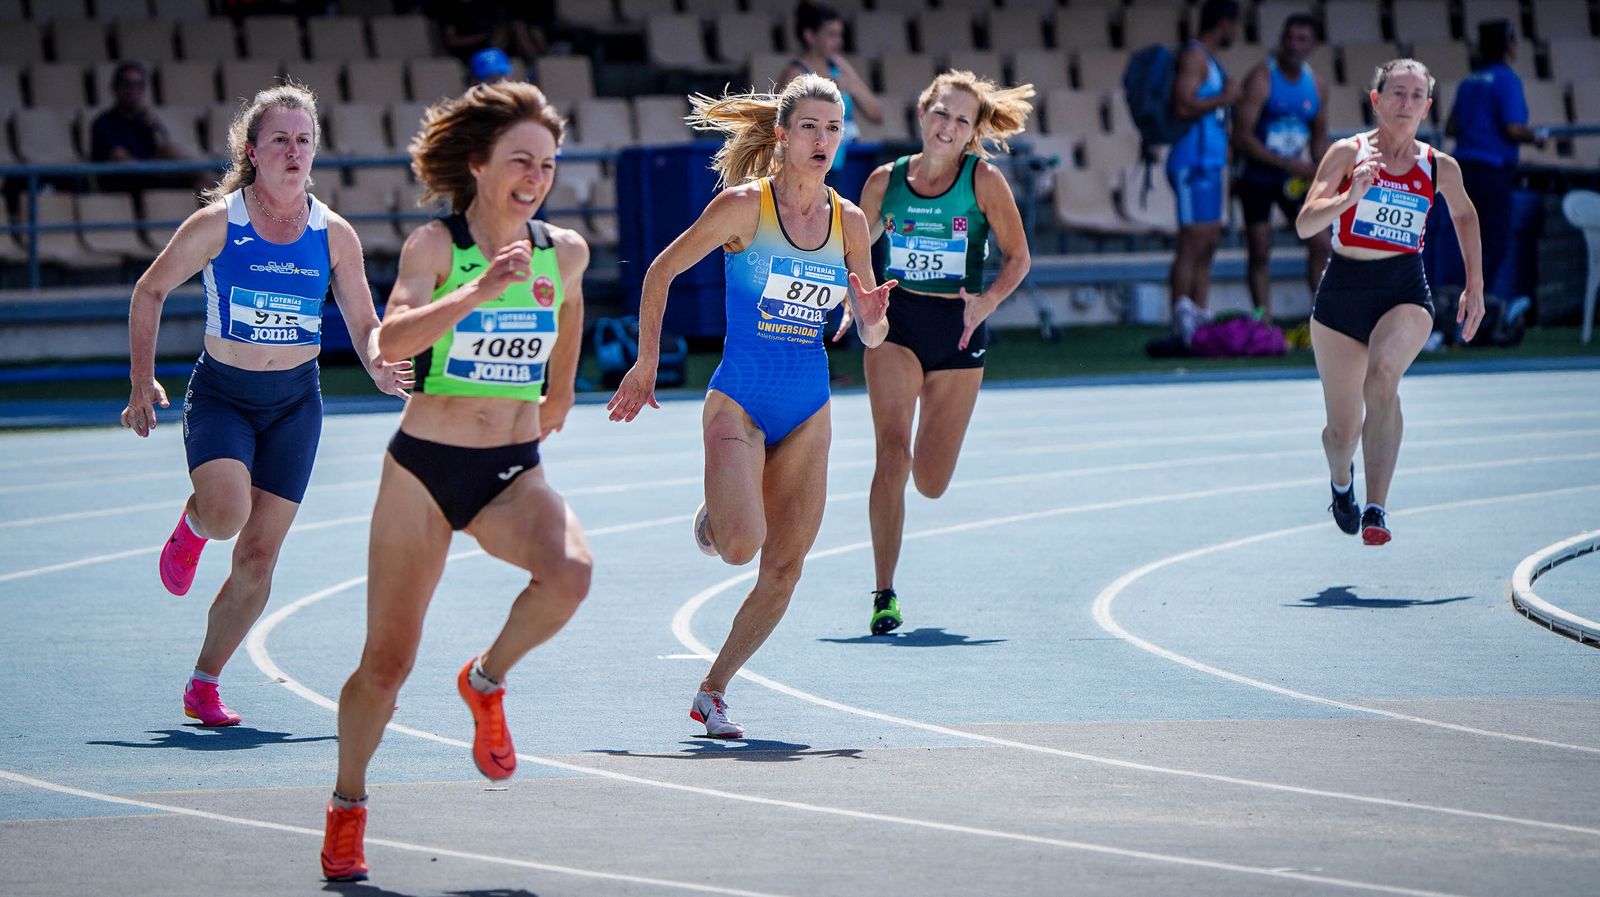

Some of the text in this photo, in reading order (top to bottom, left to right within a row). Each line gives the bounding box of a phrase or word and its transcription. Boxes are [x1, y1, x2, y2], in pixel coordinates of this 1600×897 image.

[1377, 178, 1410, 191] Joma
[1375, 206, 1414, 228] 803
[1369, 224, 1411, 243] Joma
[267, 261, 294, 269] CLUB
[805, 264, 836, 275] LOTERÍAS
[906, 252, 944, 270] 835
[269, 295, 302, 306] LOTERÍAS
[786, 280, 831, 307] 870
[778, 302, 824, 322] Joma
[250, 327, 299, 341] Joma
[757, 320, 818, 338] UNIVERSIDAD
[472, 337, 542, 359] 1089
[468, 362, 531, 381] Joma
